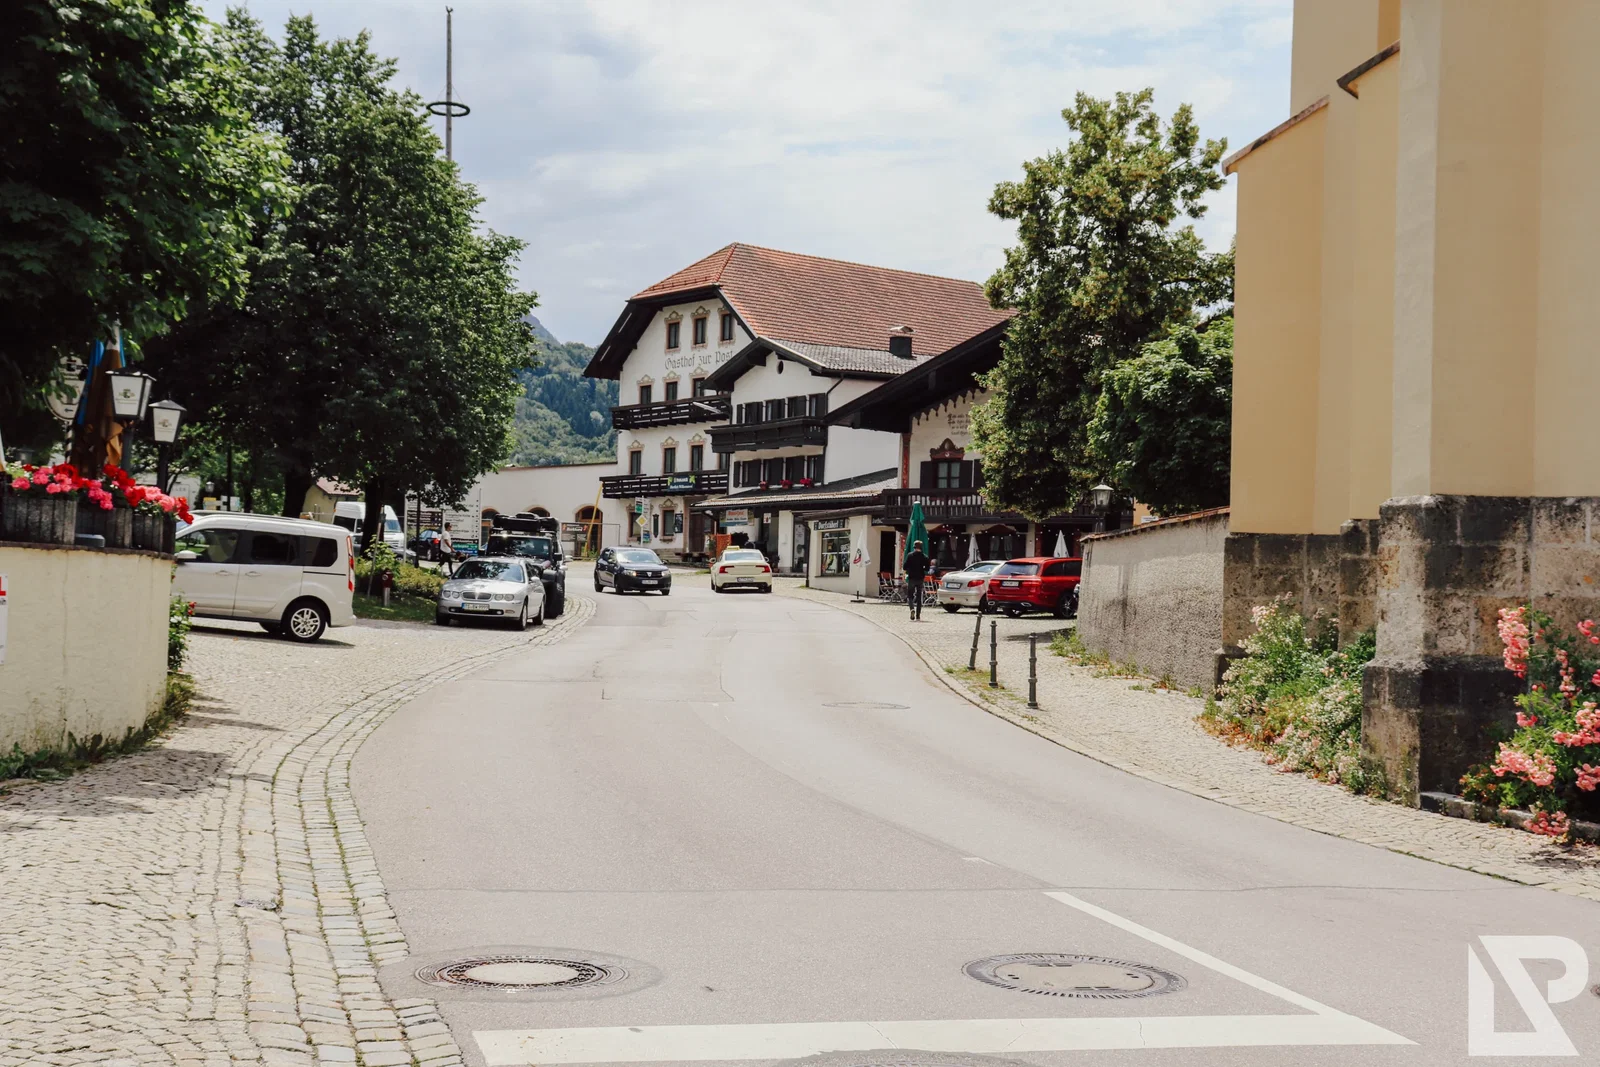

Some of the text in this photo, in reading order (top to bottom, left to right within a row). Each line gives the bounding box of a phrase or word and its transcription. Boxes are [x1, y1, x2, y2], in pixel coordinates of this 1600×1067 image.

[664, 350, 734, 370] Gasthof zur Post
